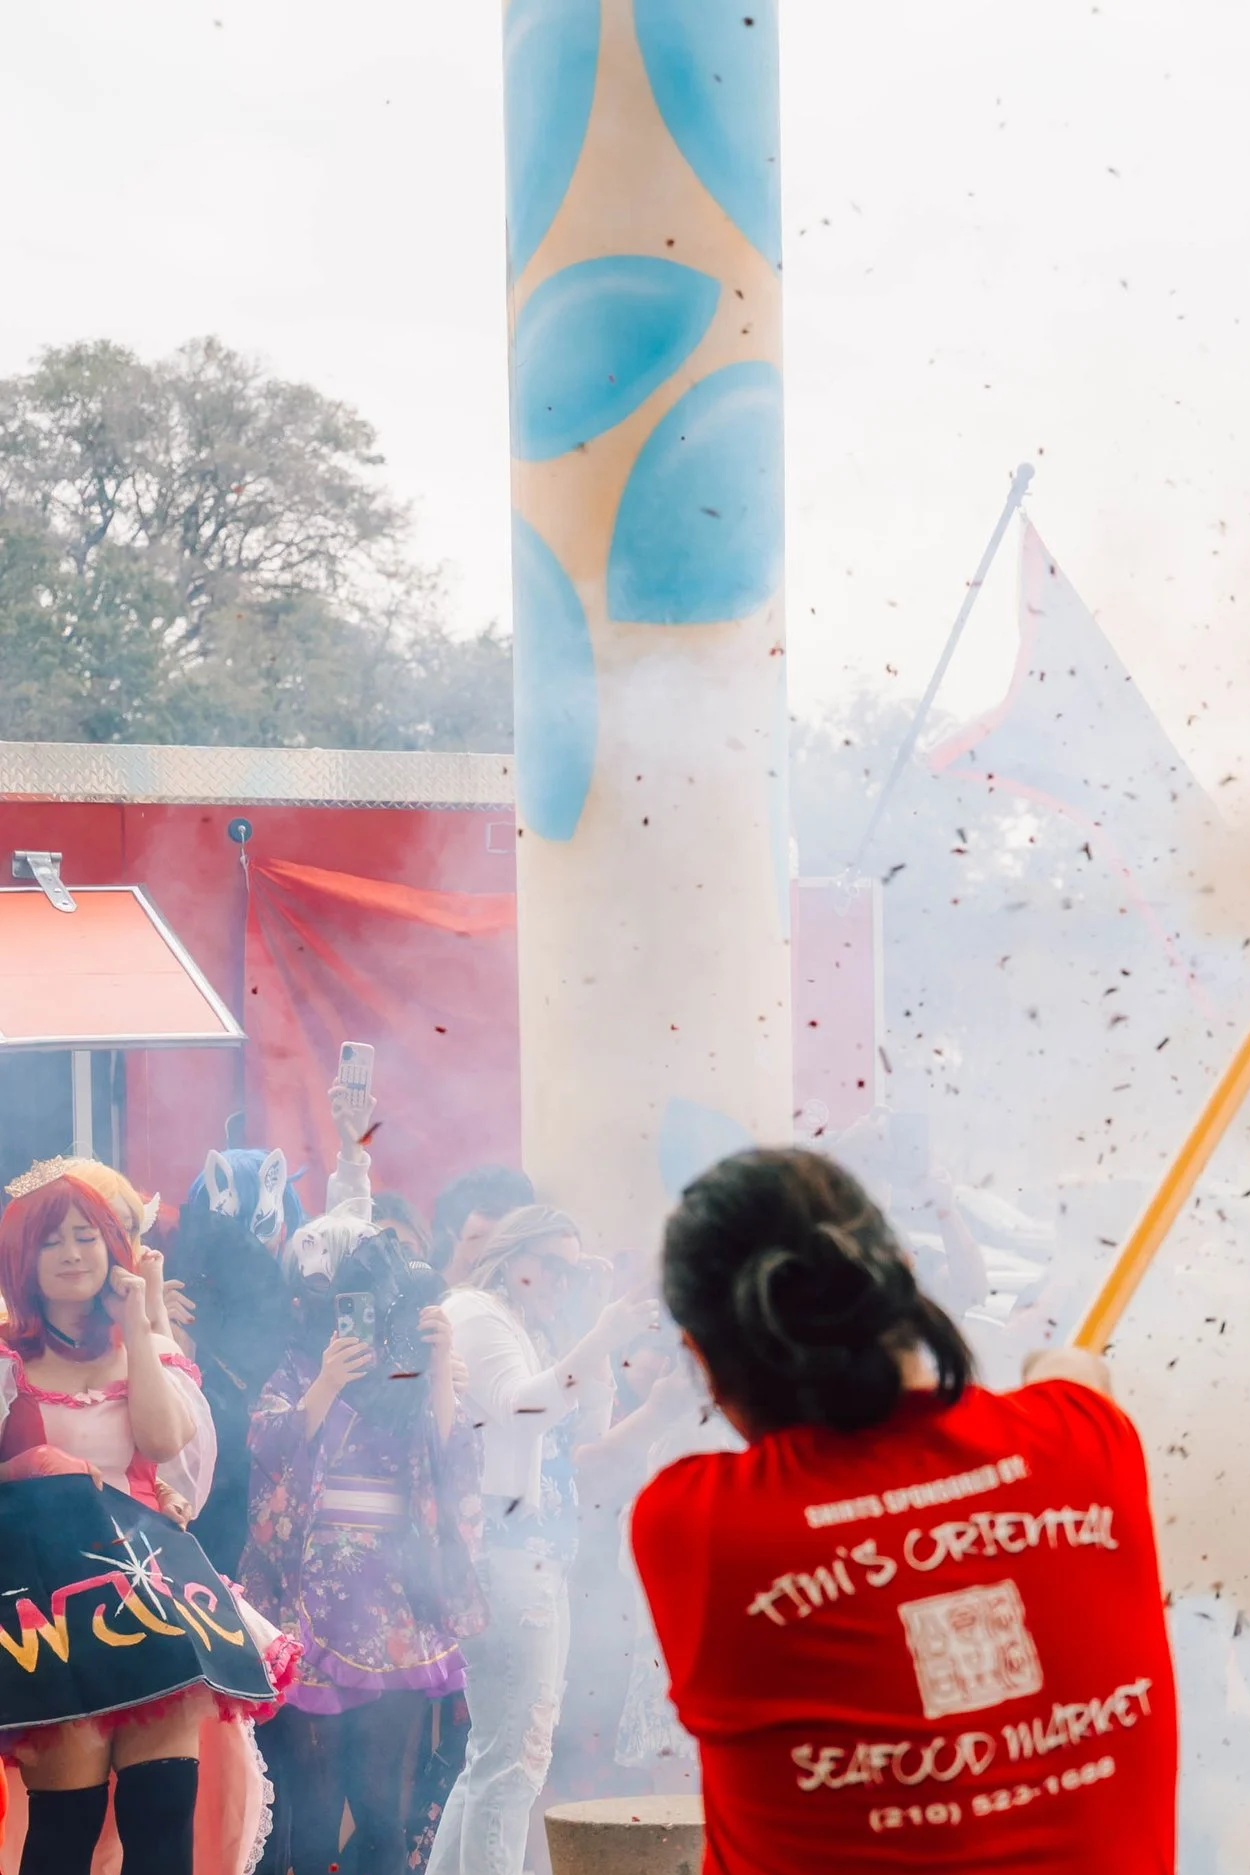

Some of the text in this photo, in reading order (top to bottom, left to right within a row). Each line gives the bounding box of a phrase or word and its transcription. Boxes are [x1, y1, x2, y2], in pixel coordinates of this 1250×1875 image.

[903, 1502, 1119, 1572] ORIENTAL
[791, 1676, 1153, 1791] SEAFOOD MARKET
